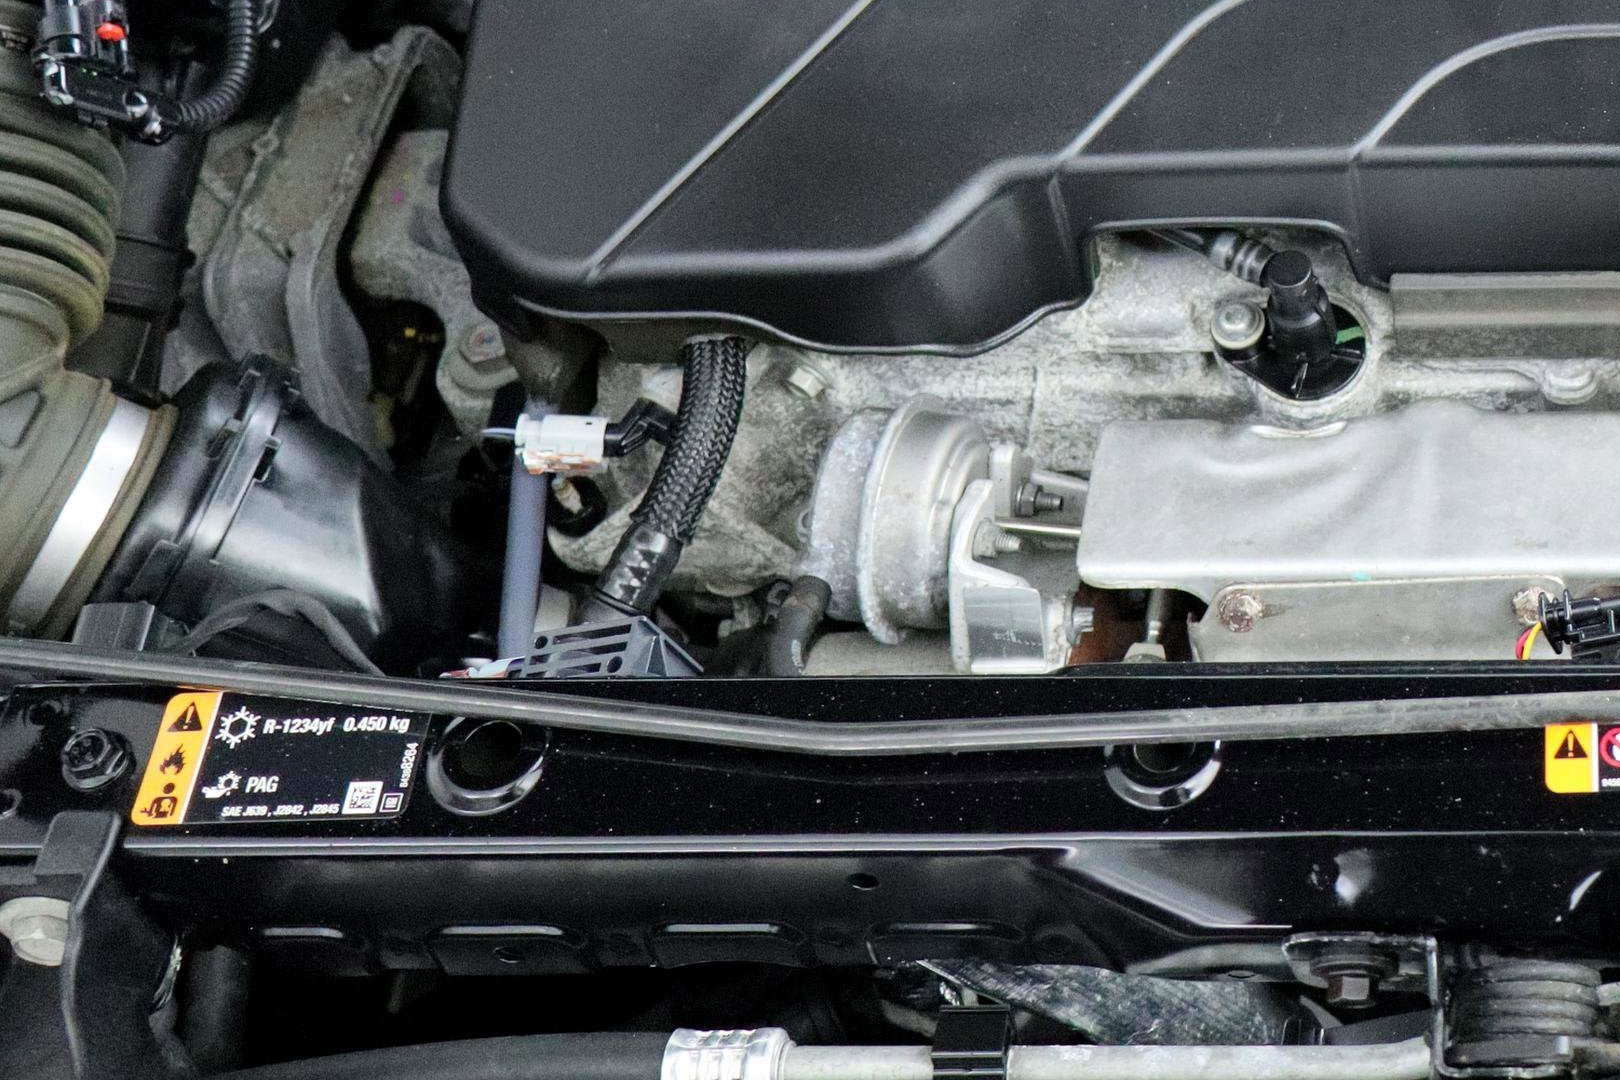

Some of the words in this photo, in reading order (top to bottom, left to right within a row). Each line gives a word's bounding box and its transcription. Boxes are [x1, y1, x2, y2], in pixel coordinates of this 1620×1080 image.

[262, 717, 336, 736] R-1234yf
[342, 716, 388, 733] 0.450
[389, 715, 411, 734] kg
[245, 775, 280, 794] PAG
[221, 805, 243, 817] SAE
